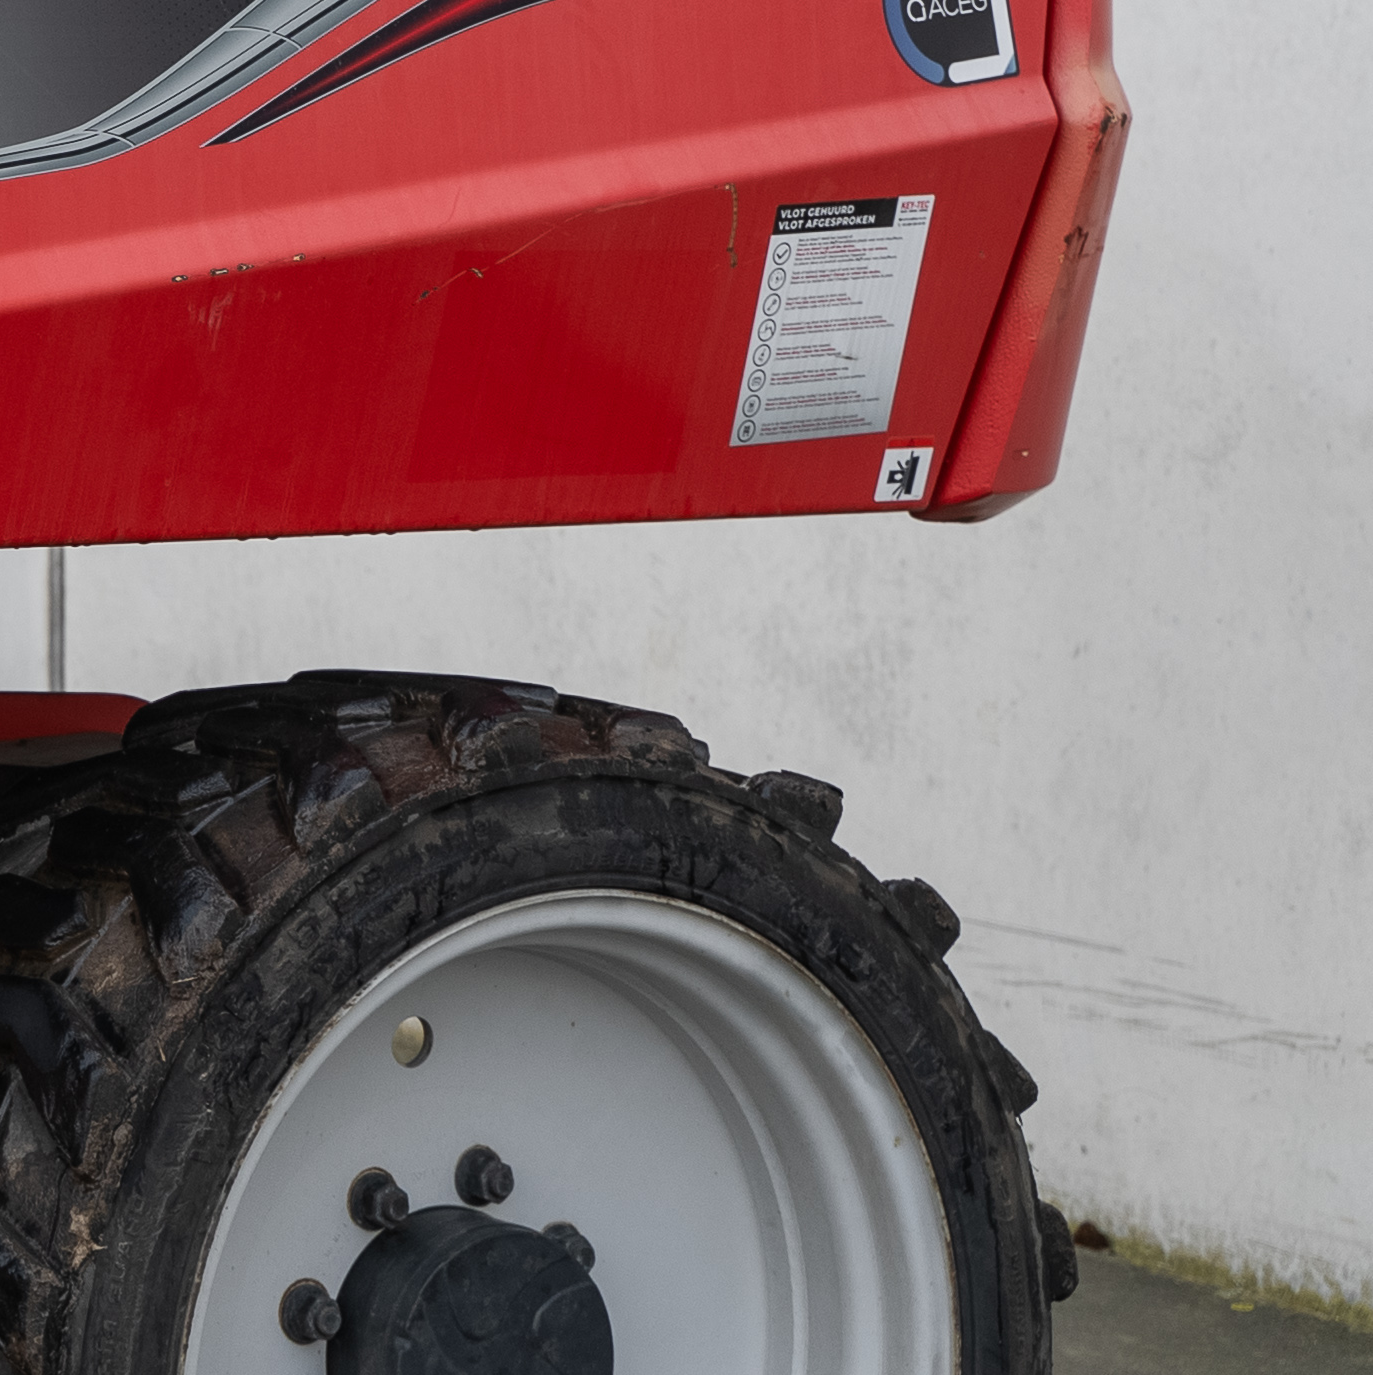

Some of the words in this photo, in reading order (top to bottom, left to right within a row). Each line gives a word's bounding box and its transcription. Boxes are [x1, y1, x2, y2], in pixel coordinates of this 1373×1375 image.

[780, 208, 806, 219] VLOT
[807, 204, 856, 218] GEHUURD
[778, 219, 803, 231] VLOT
[805, 214, 876, 229] AFGESPROKEN
